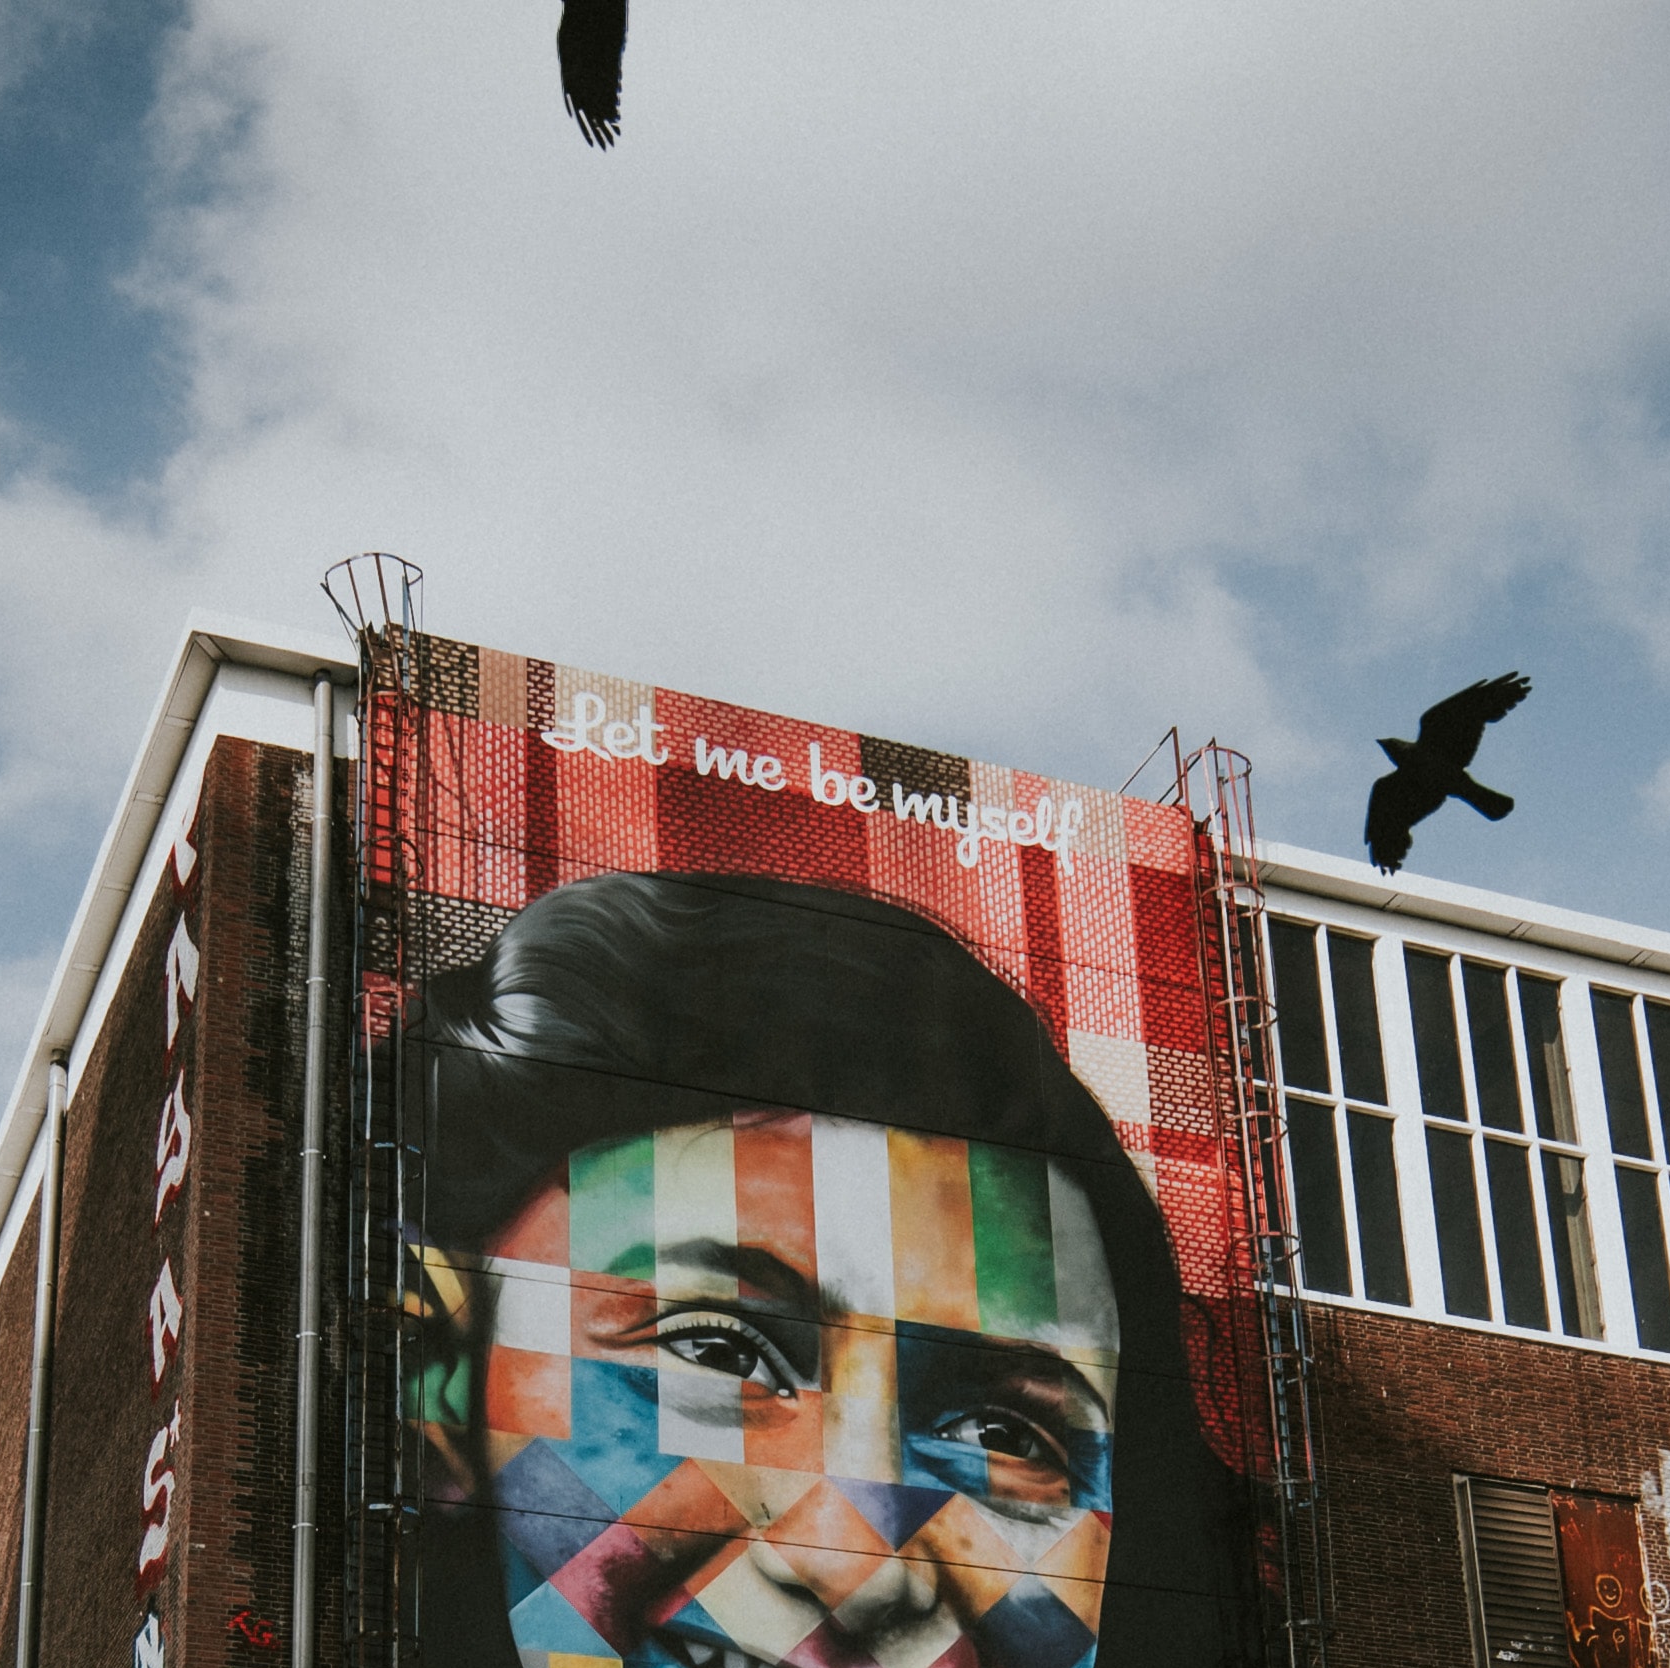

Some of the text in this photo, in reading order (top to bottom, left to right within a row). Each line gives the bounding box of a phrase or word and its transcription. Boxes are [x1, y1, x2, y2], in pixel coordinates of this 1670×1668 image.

[540, 690, 1083, 876] Let me be myself
